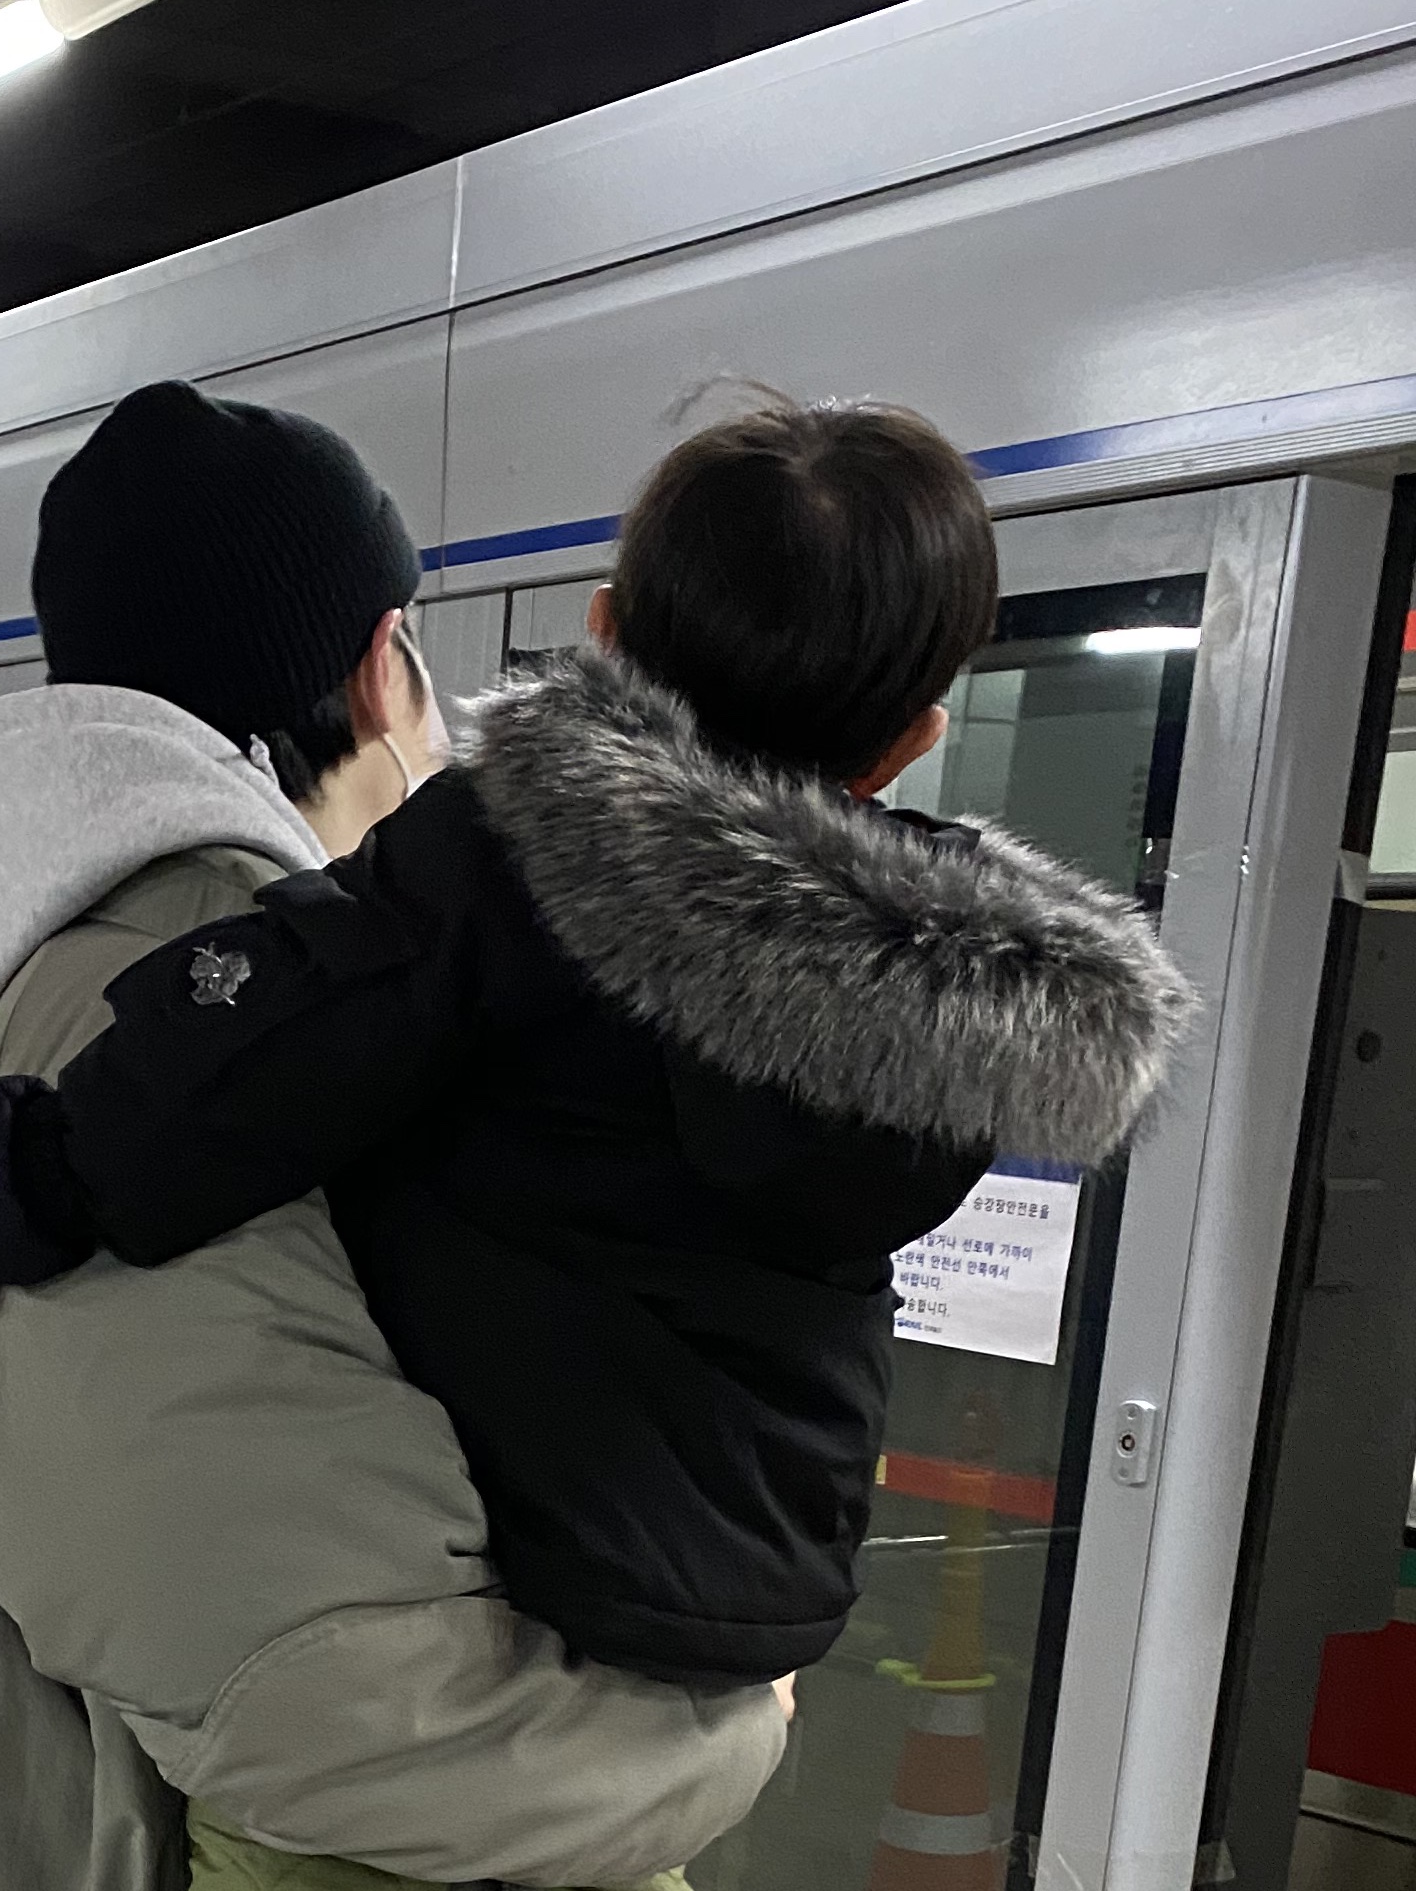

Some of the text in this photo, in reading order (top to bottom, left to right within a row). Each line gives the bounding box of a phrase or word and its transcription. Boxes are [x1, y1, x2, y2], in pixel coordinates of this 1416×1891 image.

[973, 1196, 1050, 1220] 승강장안전문을
[962, 1238, 994, 1256] 선로에
[1000, 1243, 1033, 1262] 가까이
[894, 1252, 1010, 1281] 노란색 안전선 안쪽에서
